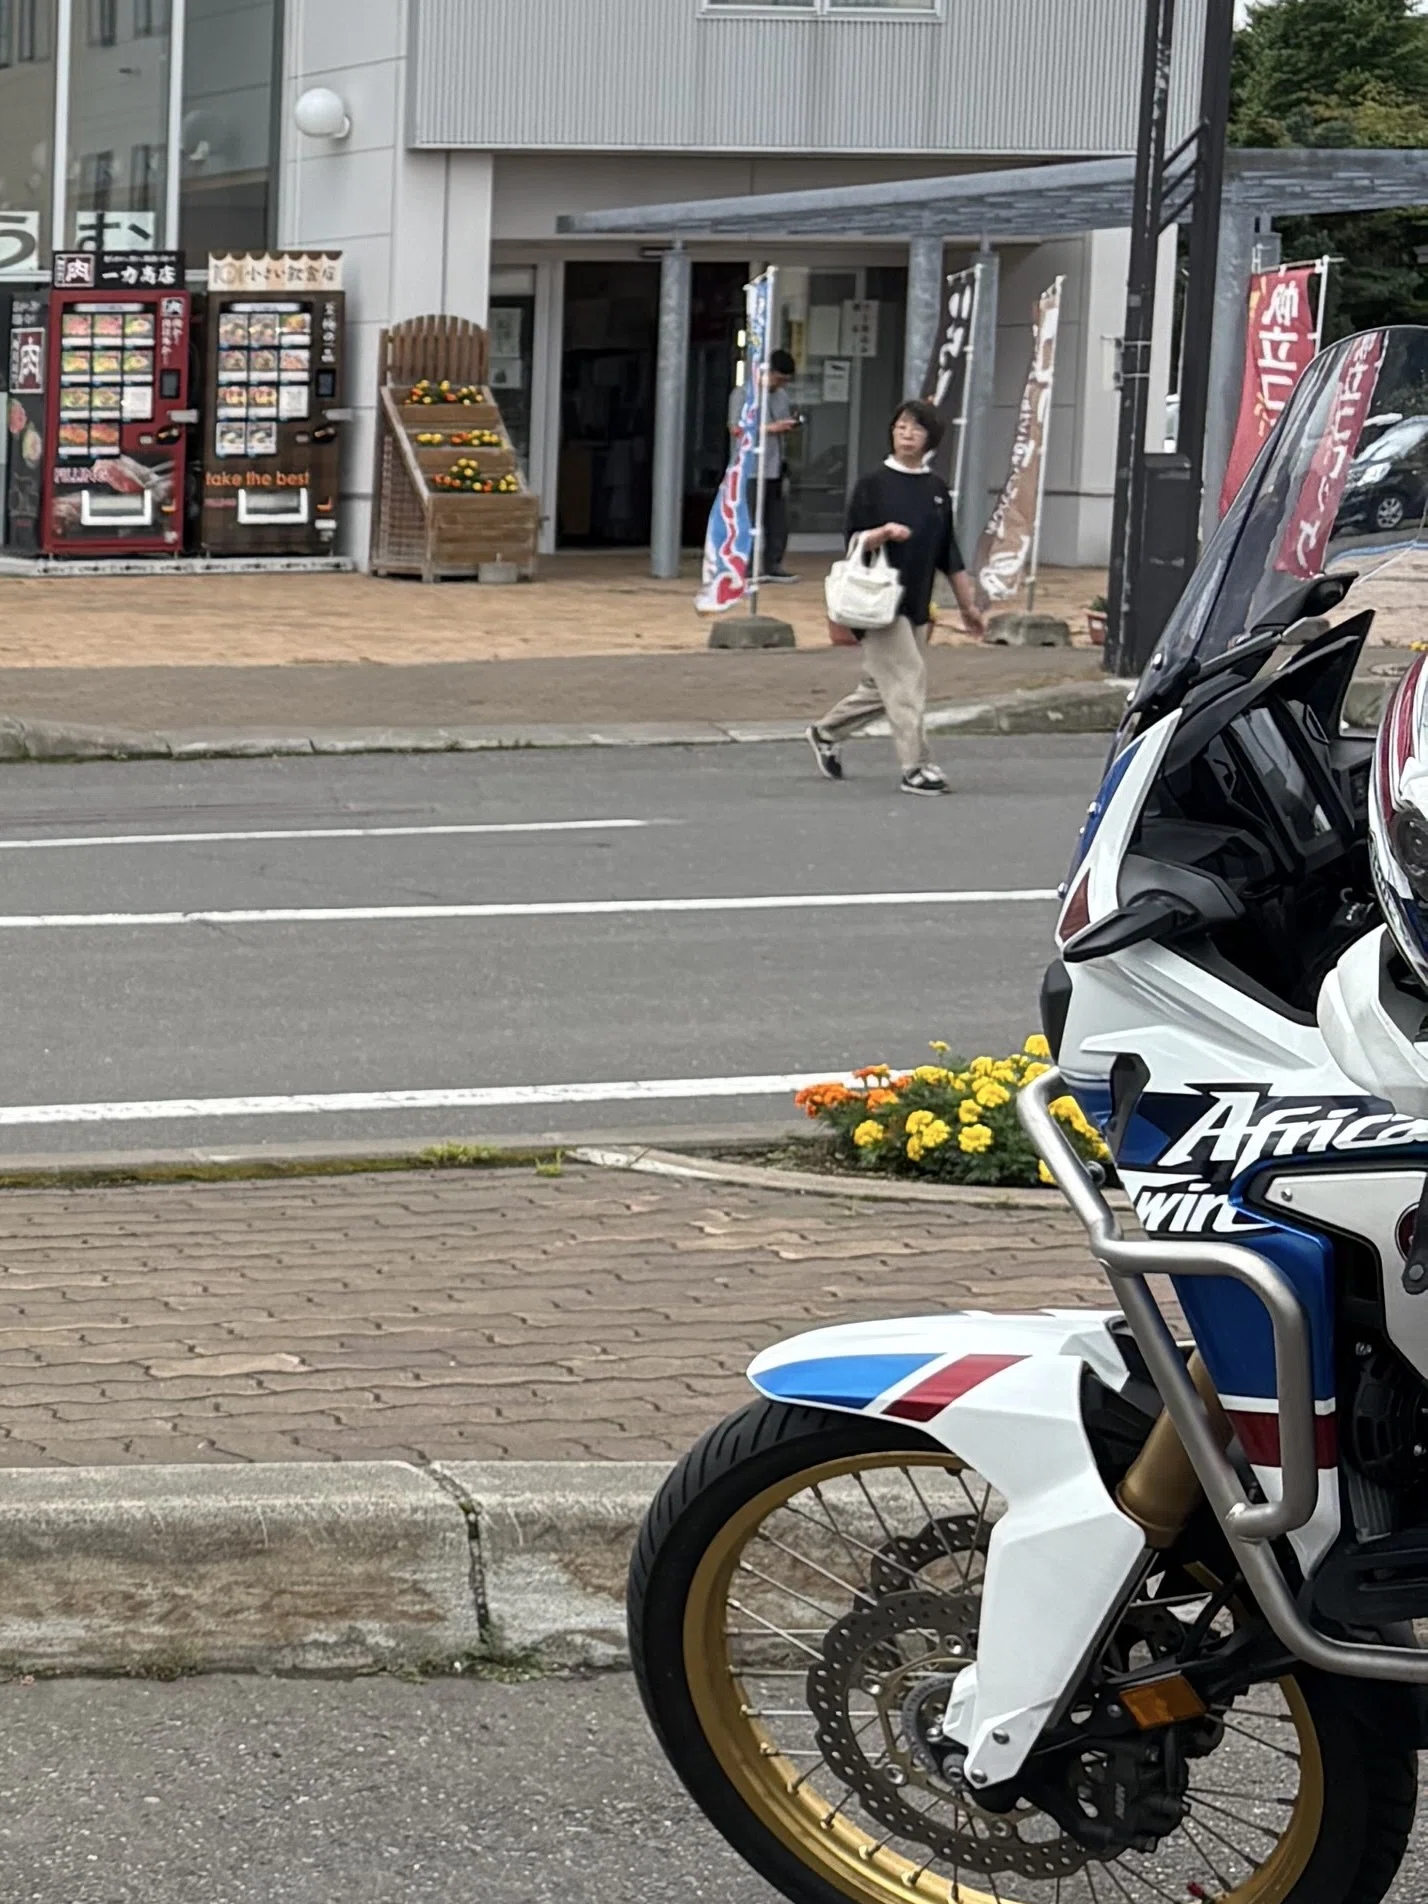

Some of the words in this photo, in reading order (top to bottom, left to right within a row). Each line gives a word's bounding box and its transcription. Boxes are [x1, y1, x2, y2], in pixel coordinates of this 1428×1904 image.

[206, 471, 241, 486] take
[246, 471, 271, 486] the
[276, 470, 310, 486] best
[1157, 1091, 1428, 1180] Africa
